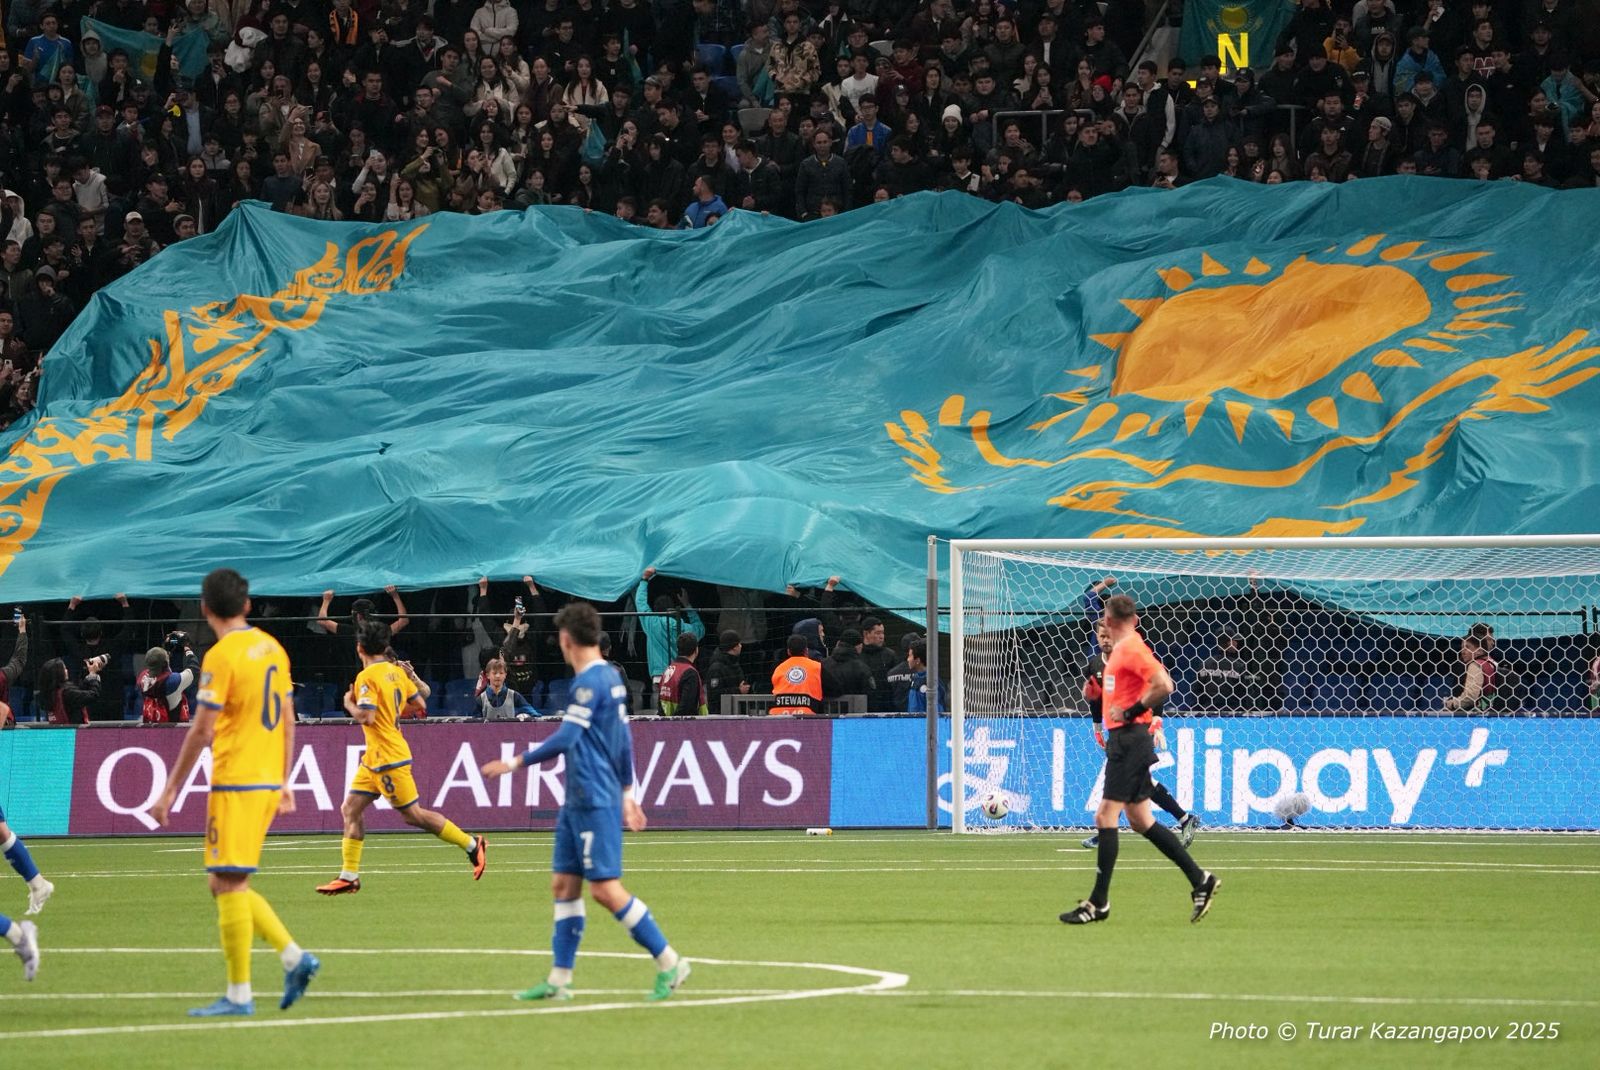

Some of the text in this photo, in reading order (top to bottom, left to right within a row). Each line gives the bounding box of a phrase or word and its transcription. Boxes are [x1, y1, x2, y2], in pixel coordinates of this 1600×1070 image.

[1218, 32, 1249, 75] N
[261, 665, 281, 731] 6
[96, 745, 394, 831] QAA
[382, 774, 395, 793] 8
[207, 816, 218, 845] 6
[580, 831, 594, 856] 7
